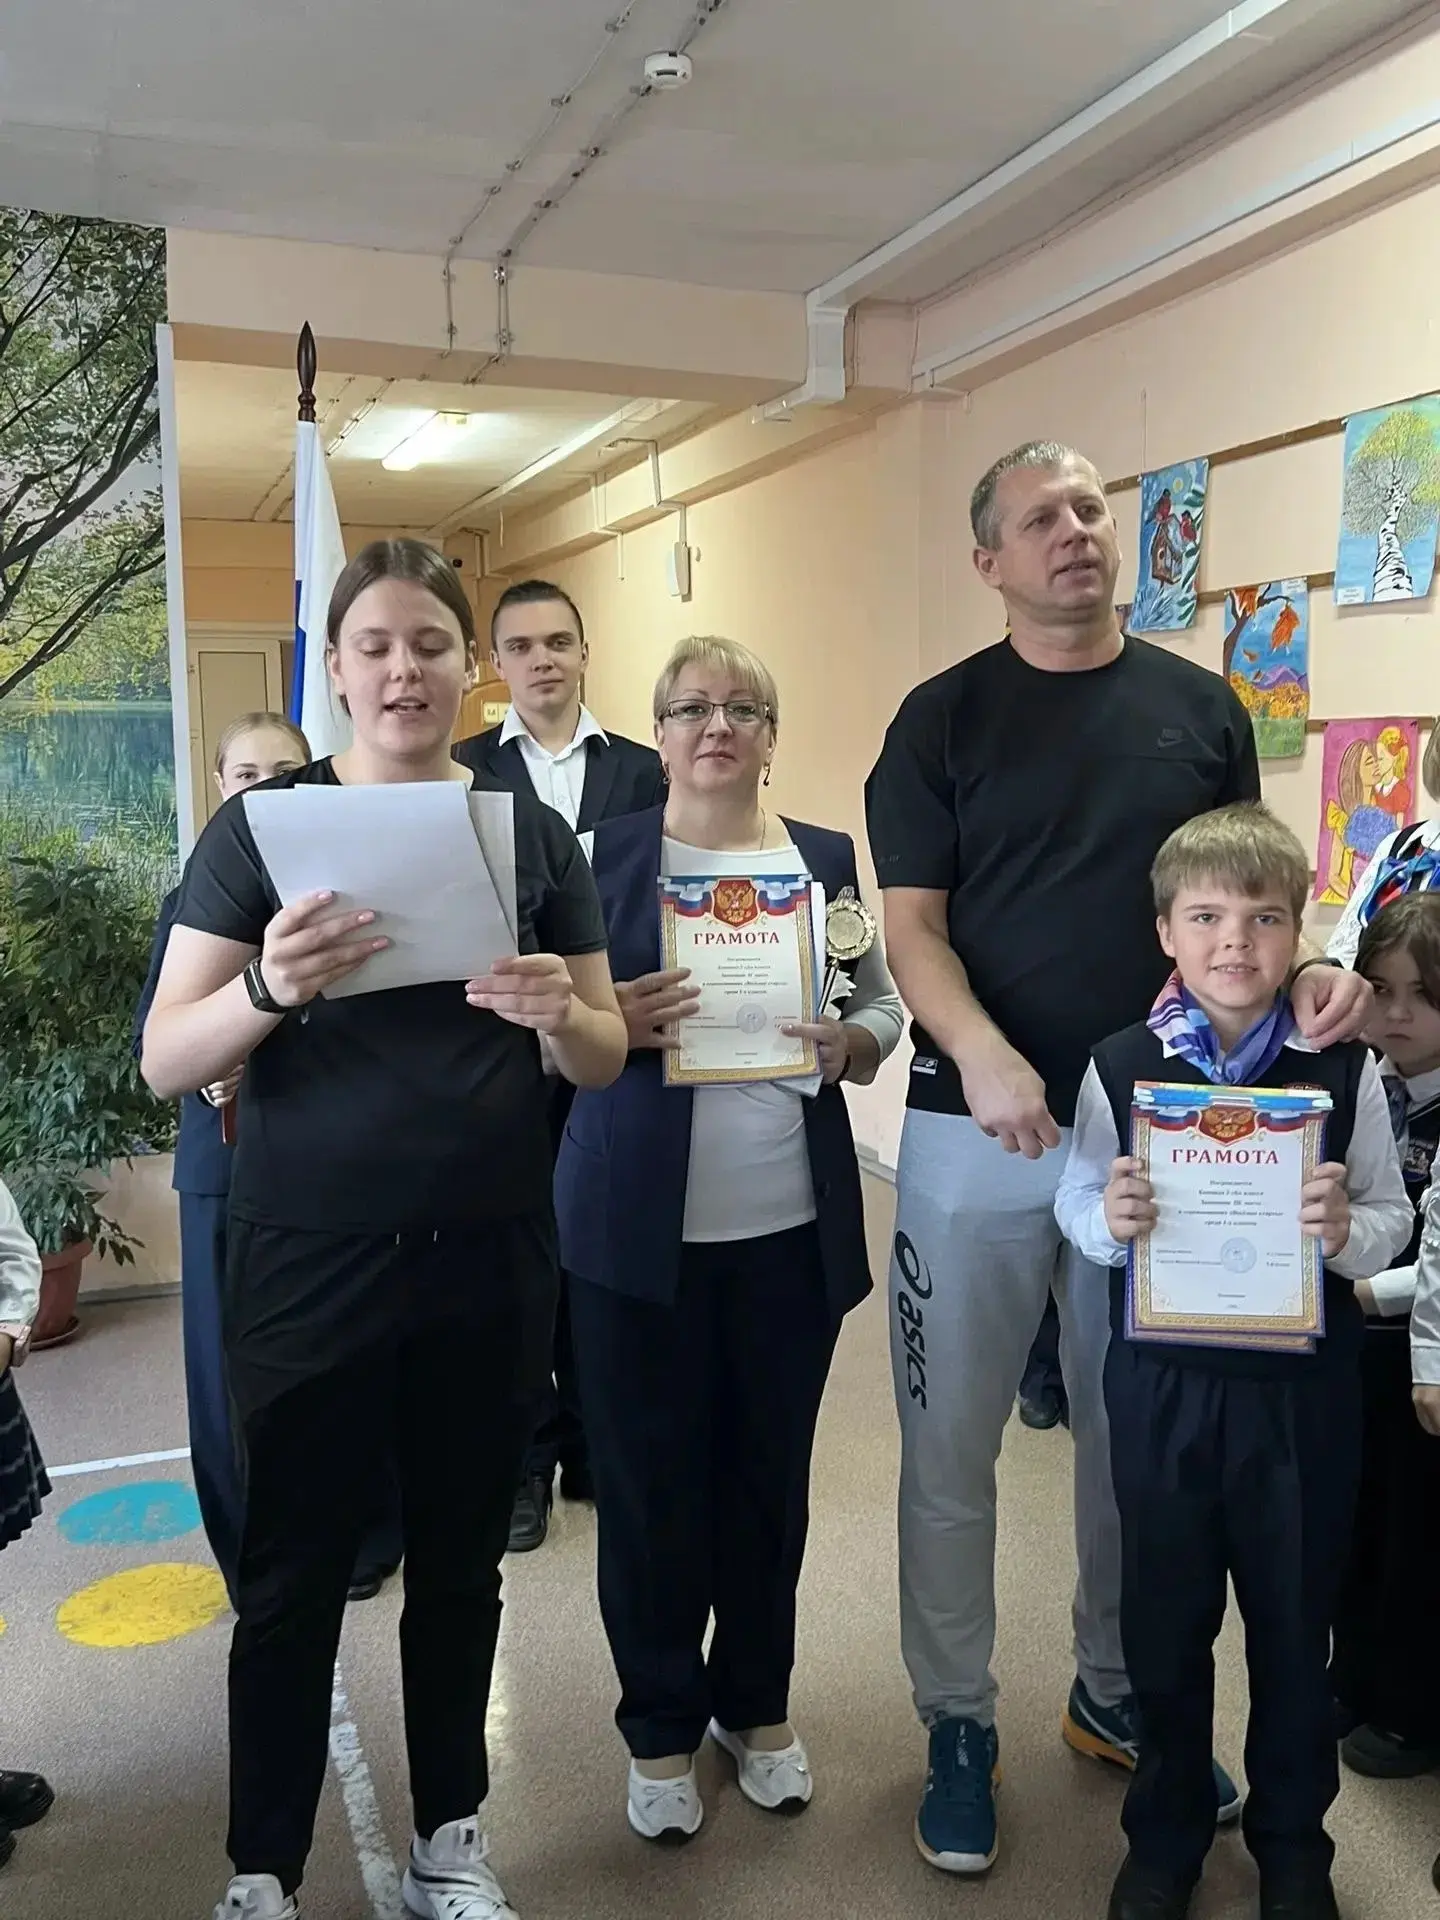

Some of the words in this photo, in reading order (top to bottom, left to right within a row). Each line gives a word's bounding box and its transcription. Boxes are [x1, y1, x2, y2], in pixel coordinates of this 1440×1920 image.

[693, 931, 780, 945] ГРАМОТА
[1172, 1149, 1279, 1164] ГРАМОТА
[898, 1291, 927, 1411] asics
